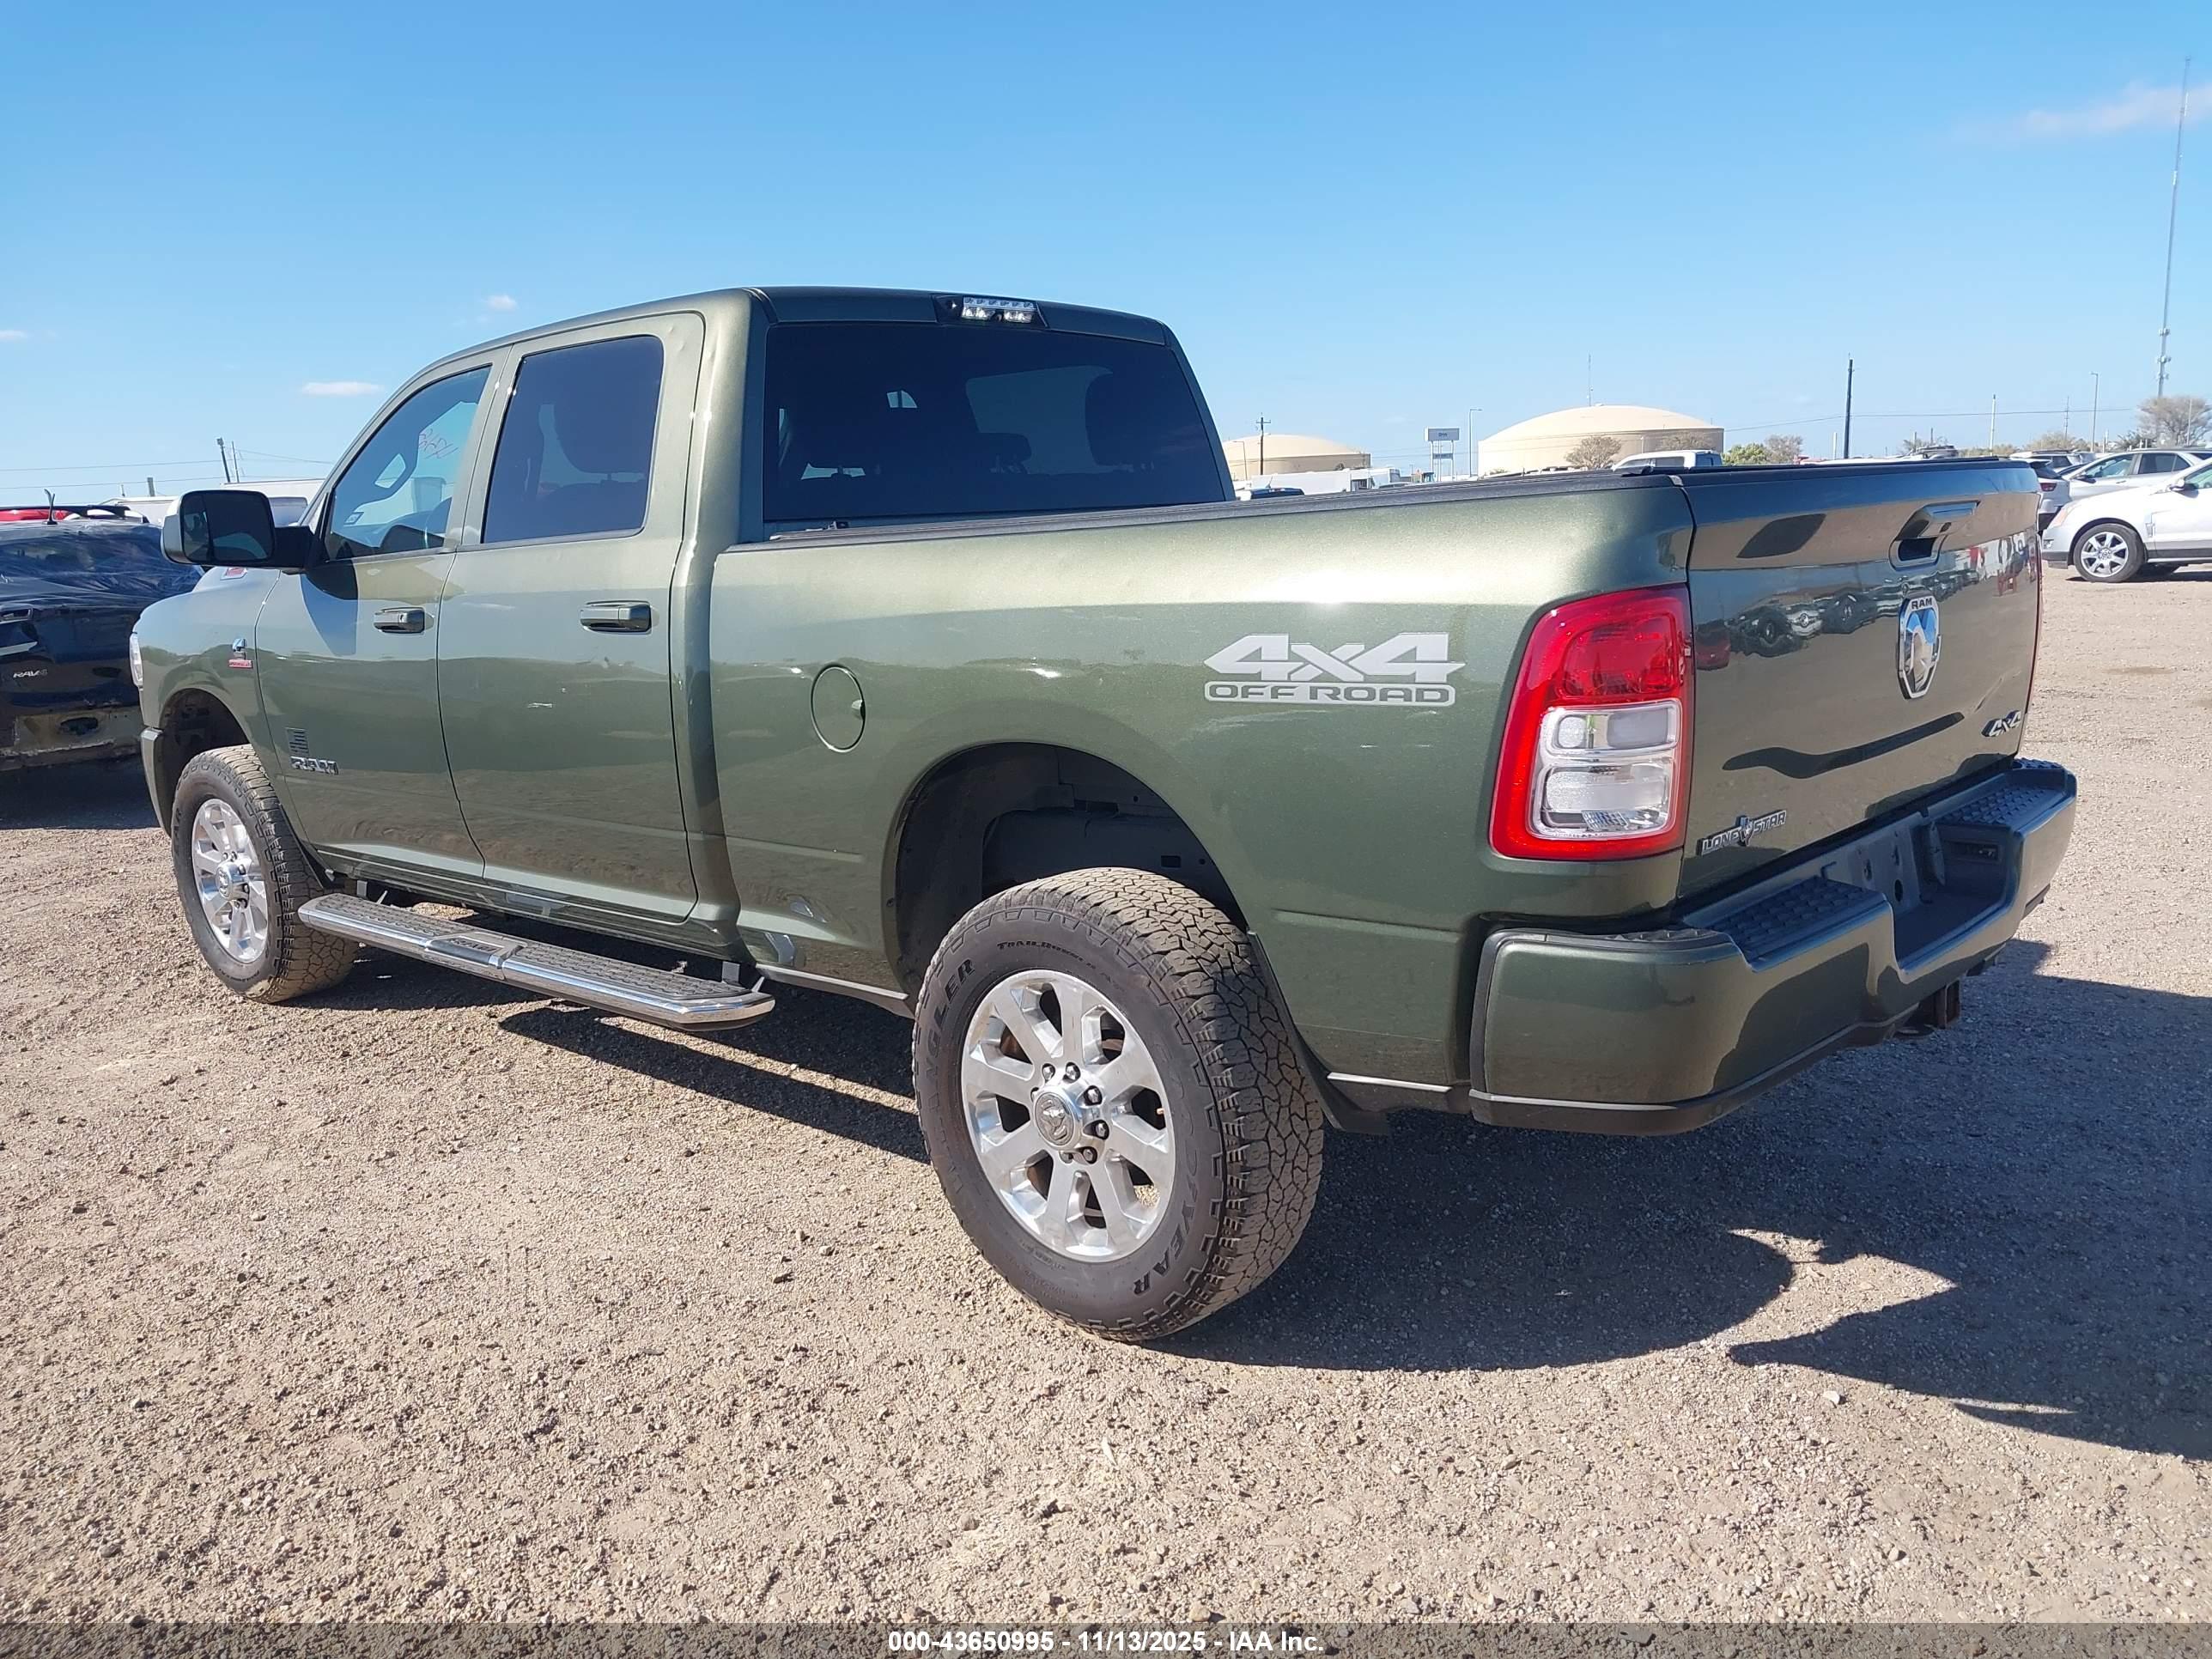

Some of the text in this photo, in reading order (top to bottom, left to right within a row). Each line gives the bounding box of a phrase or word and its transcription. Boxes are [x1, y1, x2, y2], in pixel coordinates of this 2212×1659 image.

[1911, 598, 1933, 610] RAM
[1209, 684, 1449, 703] OFF ROAD
[290, 756, 338, 775] RAM
[1702, 810, 1787, 856] LONE STAR
